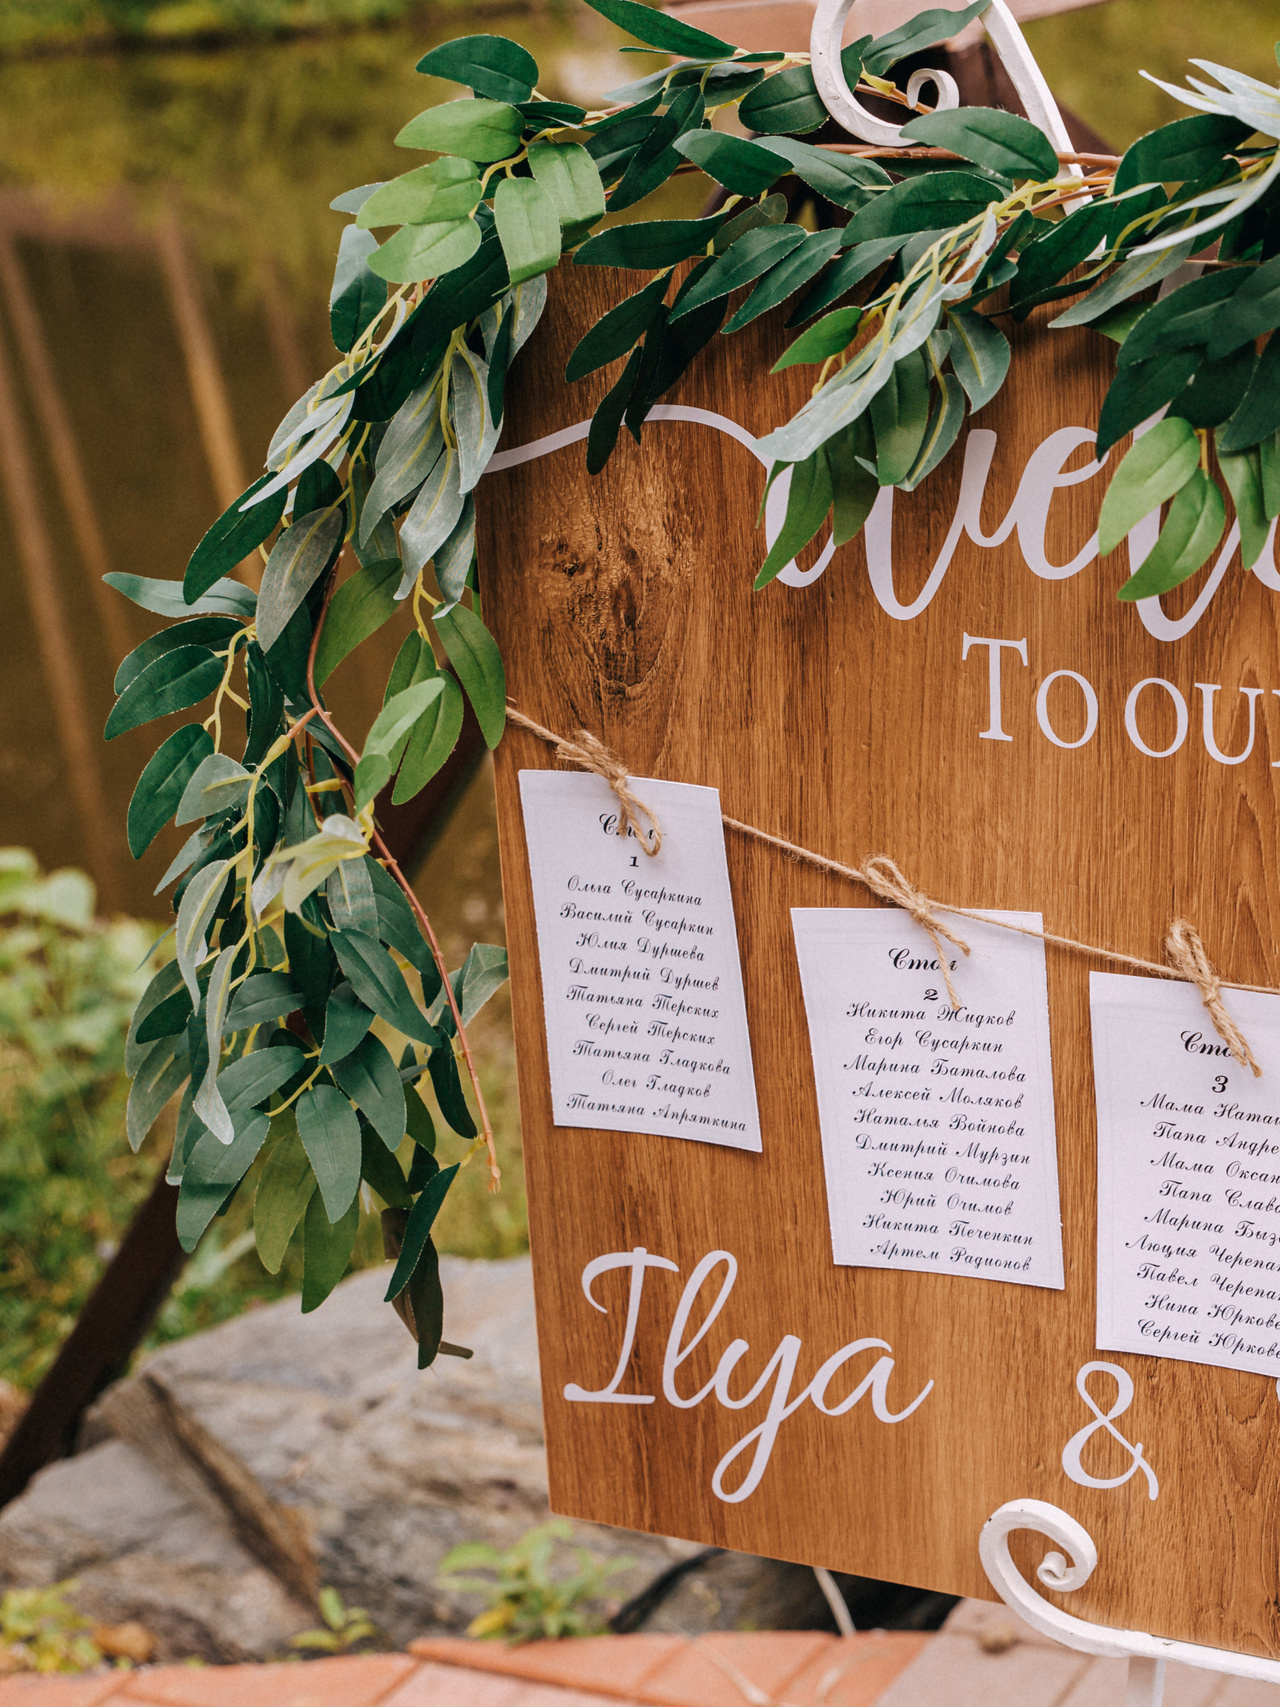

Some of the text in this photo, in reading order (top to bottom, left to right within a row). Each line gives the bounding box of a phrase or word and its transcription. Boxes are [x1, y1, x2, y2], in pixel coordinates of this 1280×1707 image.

[629, 856, 639, 868] 1
[567, 875, 702, 906] Ольга Сусаркина
[559, 902, 713, 935] Василий Сусаркин
[575, 932, 628, 951] Юлия
[569, 957, 651, 983] Дмитрий
[566, 984, 719, 1019] Татьяна Терских
[923, 988, 939, 1001] 2
[846, 1001, 1016, 1029] Никита Жидков
[585, 1013, 715, 1045] Сергей Терских
[864, 1027, 1003, 1054] Егор Сусаркин
[572, 1039, 730, 1075] Татьяна Гладкова
[1180, 1030, 1247, 1058] Сто
[843, 1054, 1026, 1083] Марина Баталова
[602, 1070, 712, 1098] Олег Гладков
[852, 1081, 932, 1101] Алексей
[1211, 1075, 1229, 1094] 3
[566, 1093, 645, 1116] Татьяна
[1140, 1092, 1205, 1115] Мама
[853, 1107, 940, 1129] Наталья
[1153, 1121, 1207, 1144] Папа
[855, 1133, 1030, 1167] Дмитрий Мурзин
[1150, 1151, 1215, 1174] Мама
[867, 1161, 934, 1181] Ксения
[880, 1188, 937, 1210] Юрий
[1159, 1179, 1212, 1203] Папа
[862, 1213, 1033, 1246] Никита Печенкин
[1144, 1207, 1224, 1234] Марина
[870, 1239, 1032, 1273] Артем Радионов
[1136, 1262, 1198, 1287] Павел
[1144, 1294, 1199, 1315] Нина
[1137, 1318, 1201, 1344] Сергей
[564, 1247, 934, 1503] Ilya
[1062, 1361, 1159, 1501] &
